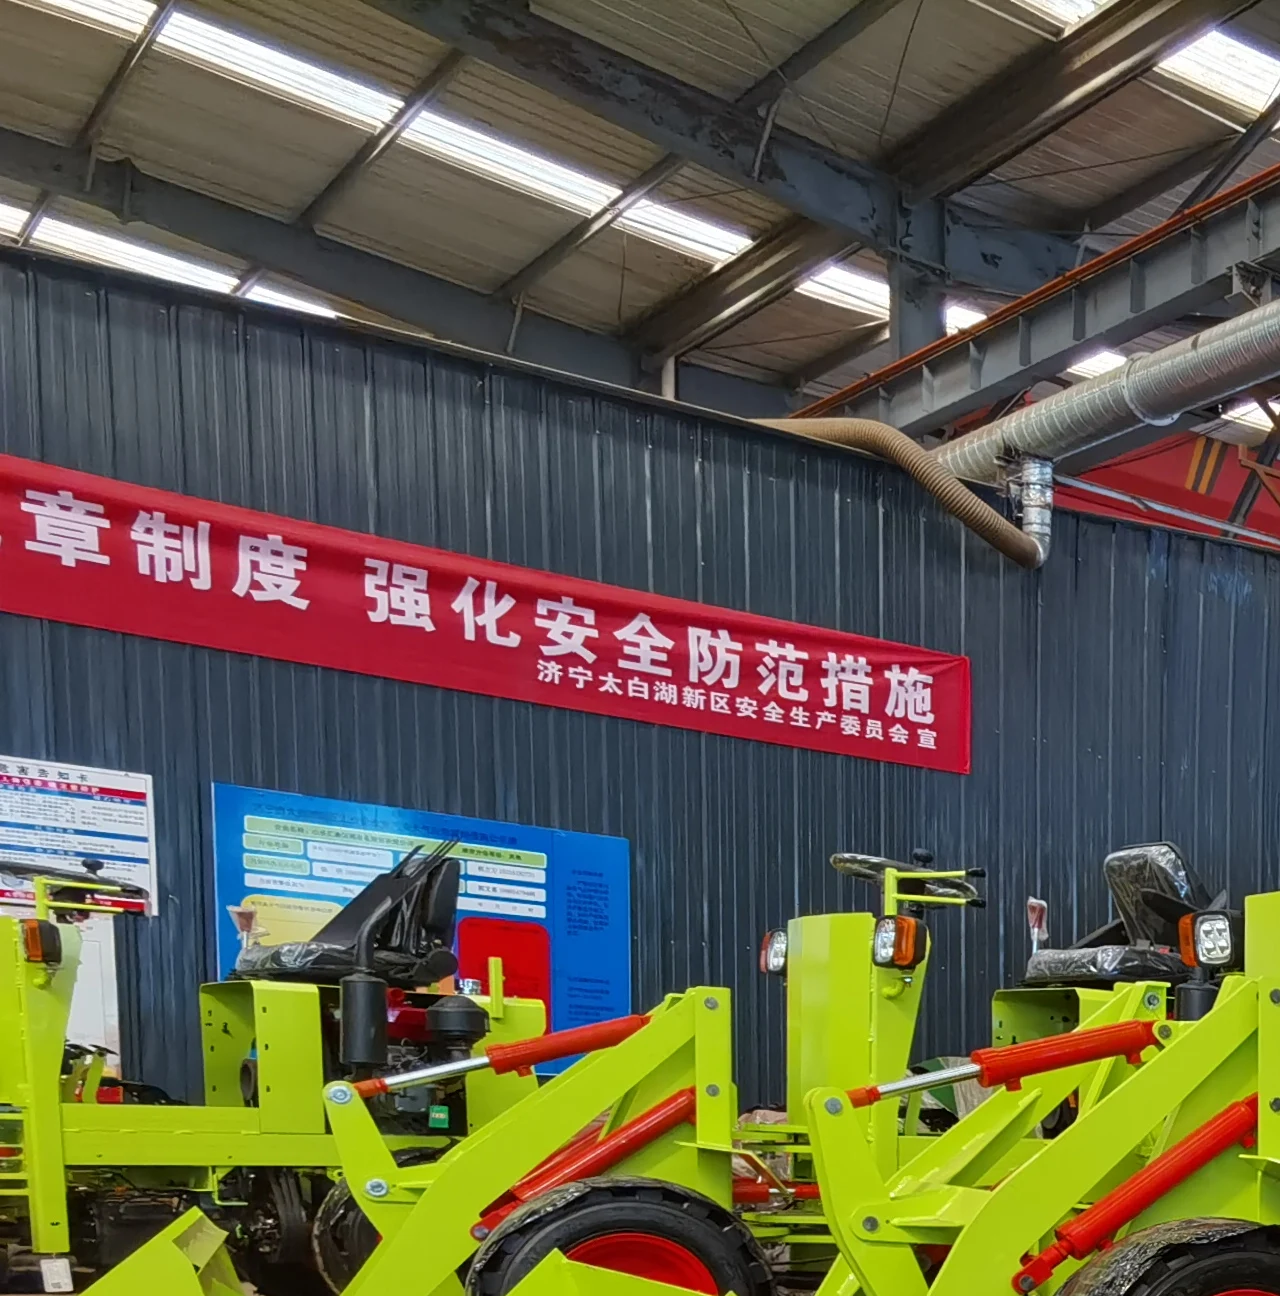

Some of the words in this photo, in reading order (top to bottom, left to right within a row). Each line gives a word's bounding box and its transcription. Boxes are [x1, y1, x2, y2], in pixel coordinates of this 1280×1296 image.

[20, 490, 310, 611] 章制度
[364, 556, 936, 724] 强化安全防范措施
